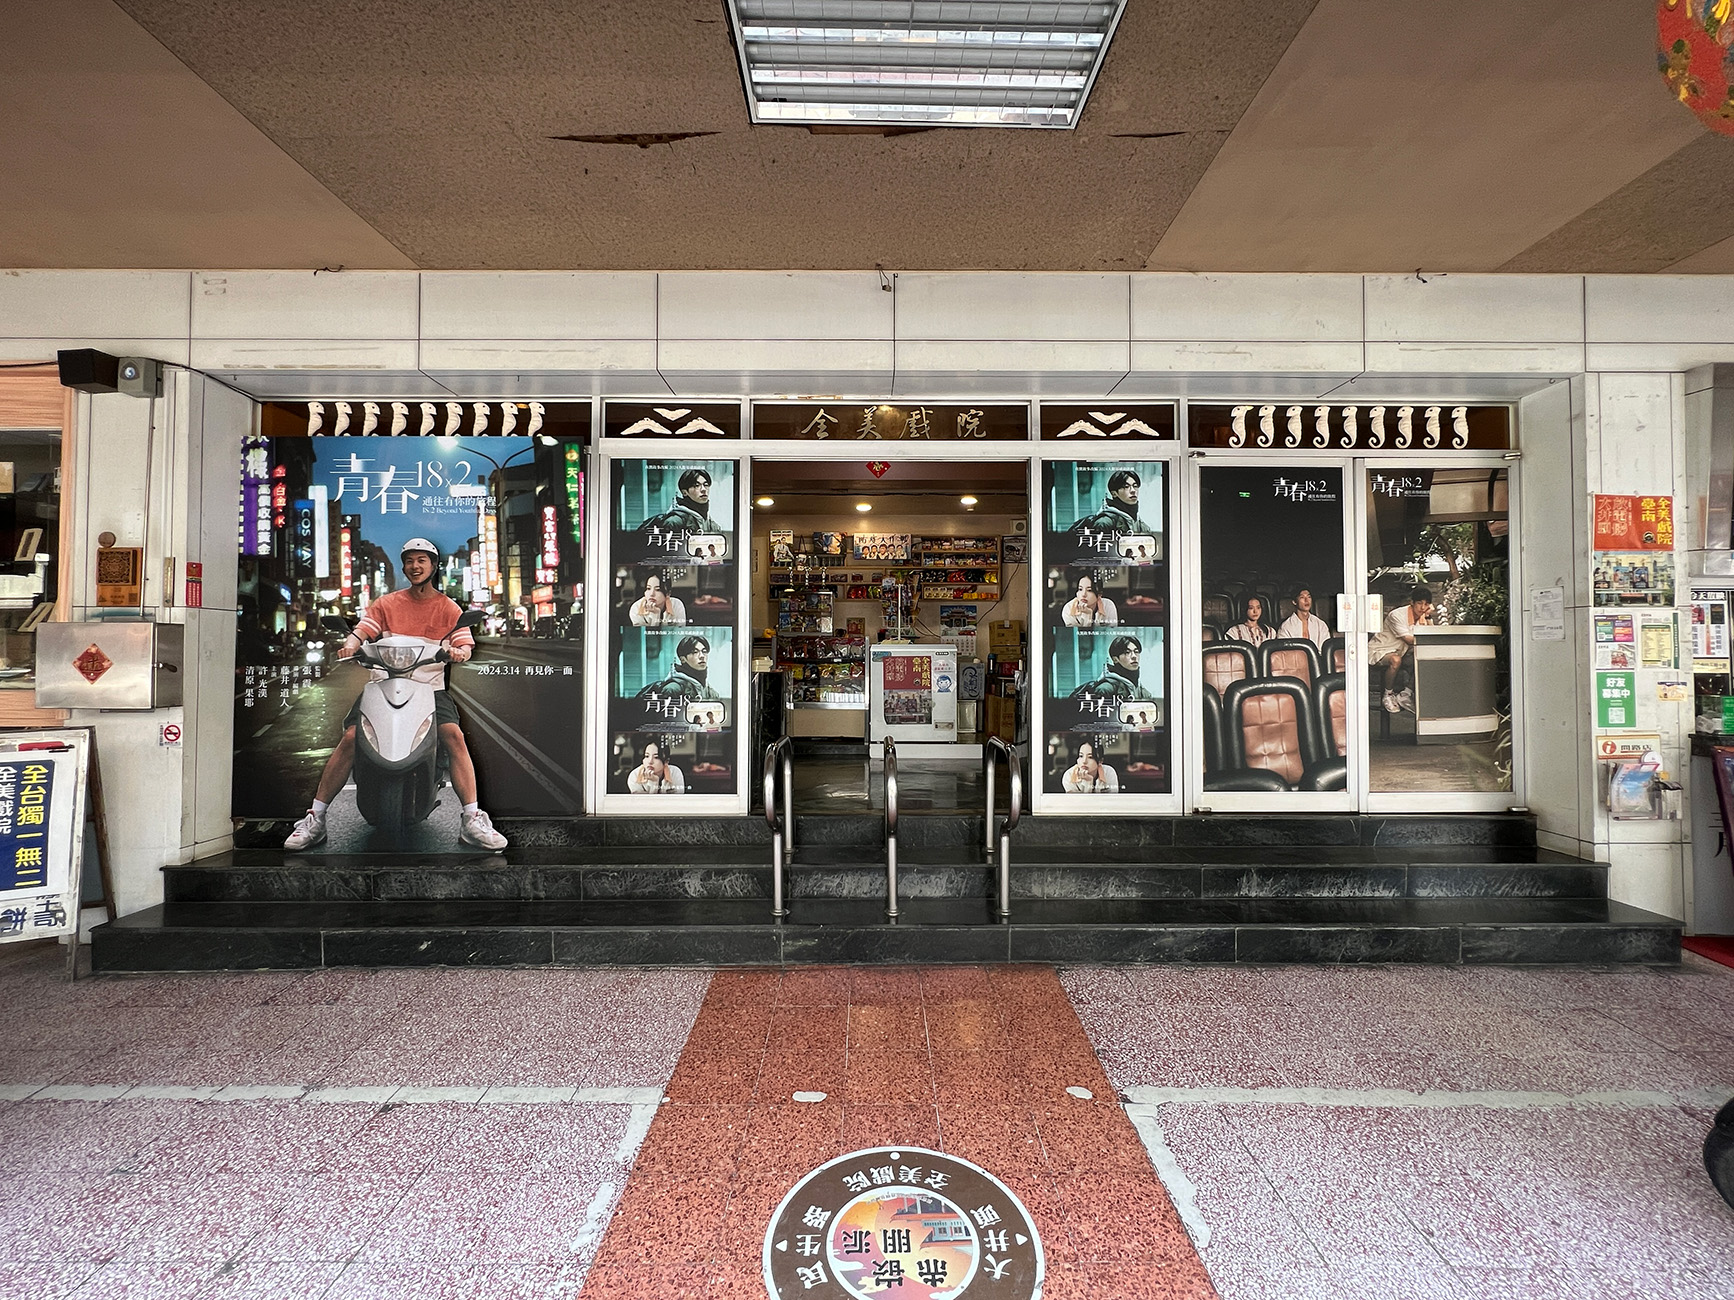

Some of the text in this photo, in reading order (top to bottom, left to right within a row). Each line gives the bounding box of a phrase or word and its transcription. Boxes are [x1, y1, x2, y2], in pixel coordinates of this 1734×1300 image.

[801, 405, 988, 440] 全美戲院
[1656, 497, 1672, 545] 全美戲院
[477, 665, 520, 676] 2024.3.14
[15, 765, 49, 887] 全台獨一無二
[842, 1164, 952, 1193] 全美戲院
[795, 1204, 833, 1290] 民生路
[969, 1203, 1013, 1281] 大井頭
